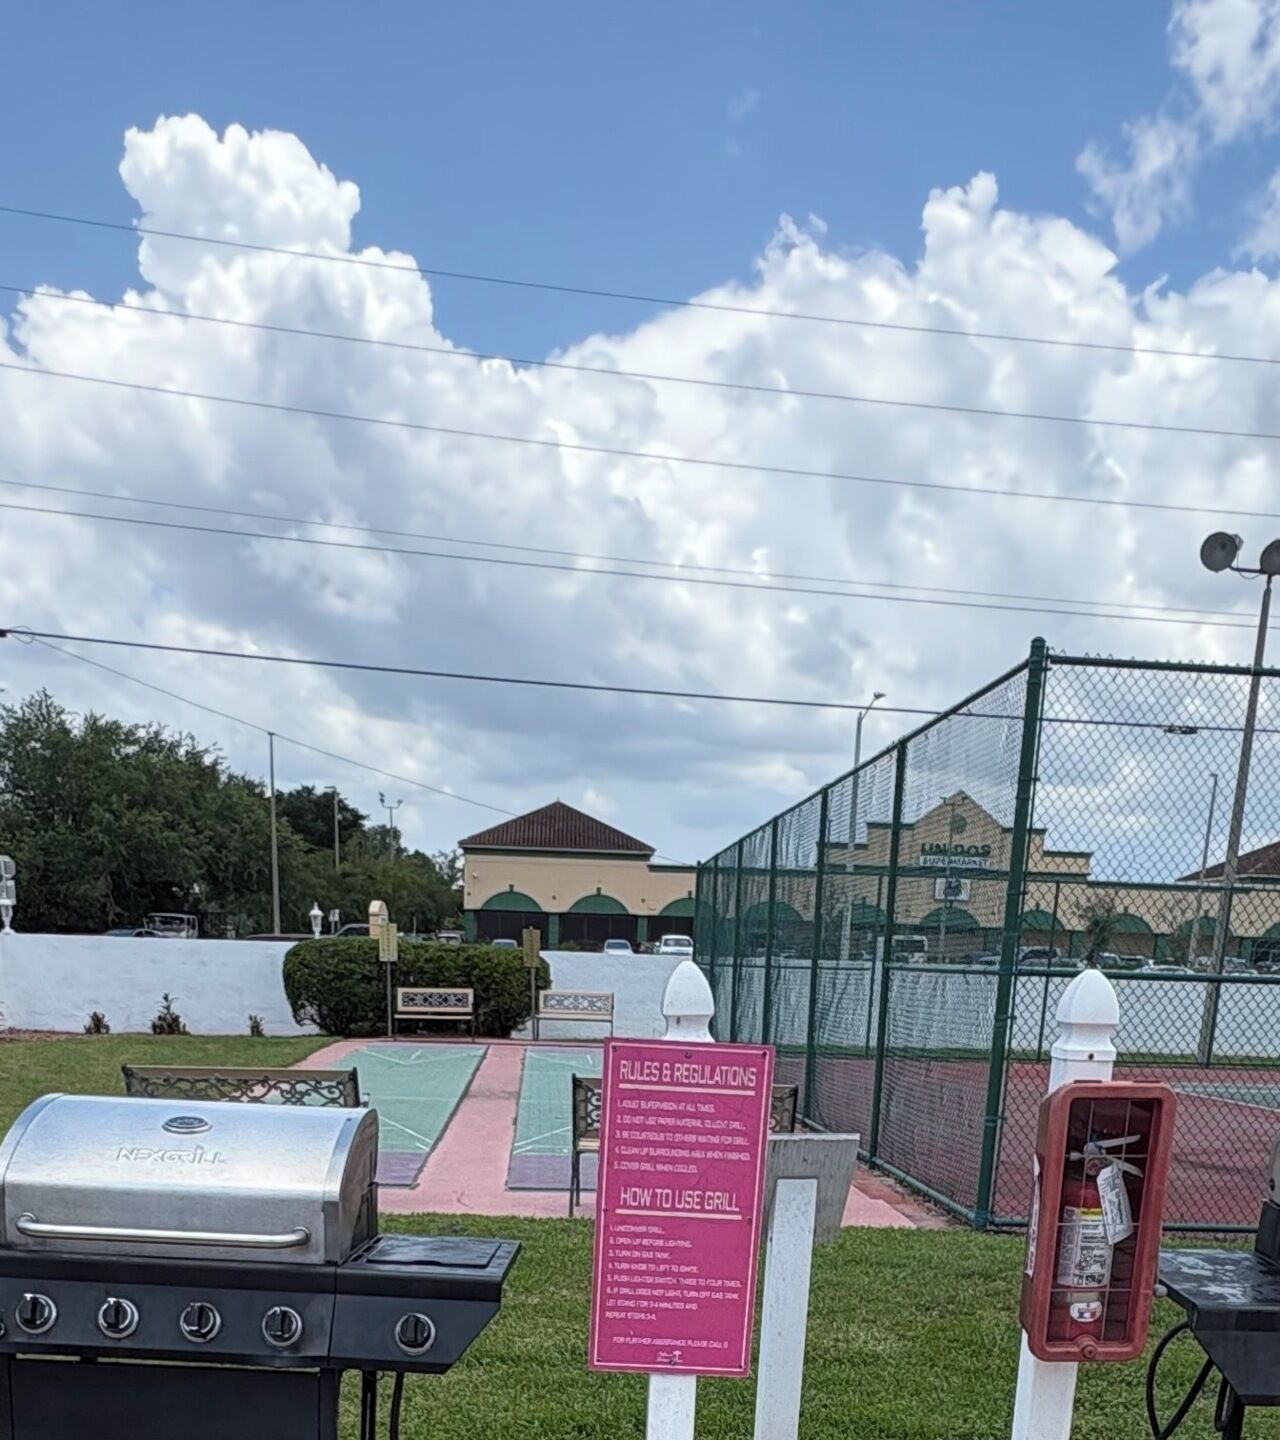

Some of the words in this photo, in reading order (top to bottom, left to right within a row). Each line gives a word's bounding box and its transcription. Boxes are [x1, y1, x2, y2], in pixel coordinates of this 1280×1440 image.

[921, 843, 991, 856] UNDOS
[620, 1060, 660, 1081] RULES
[662, 1062, 671, 1083] &
[673, 1063, 757, 1087] REGULATIONS
[658, 1116, 676, 1126] PAPER
[116, 1144, 226, 1164] NEXGRILL
[620, 1187, 653, 1207] HOW
[655, 1188, 673, 1208] TO
[675, 1190, 702, 1209] USE
[704, 1191, 740, 1212] GRILL
